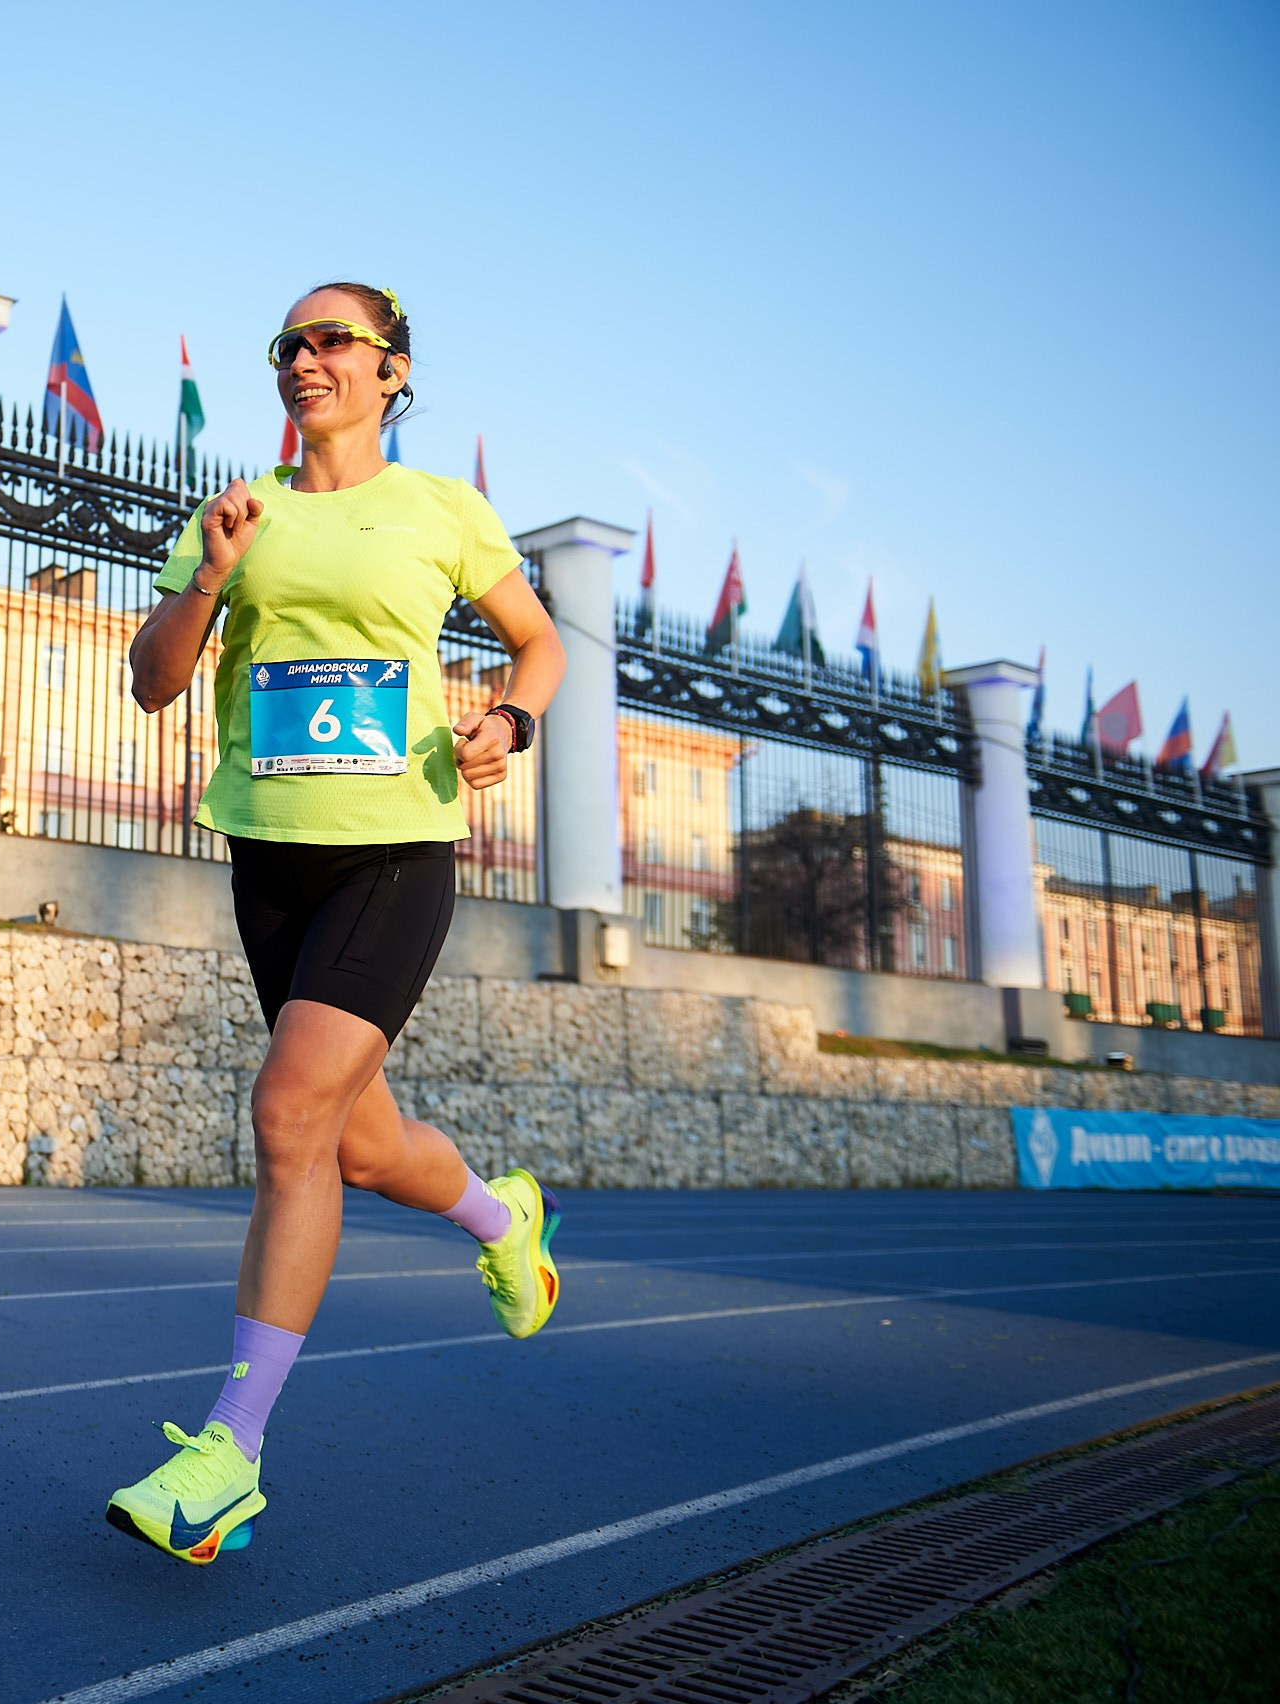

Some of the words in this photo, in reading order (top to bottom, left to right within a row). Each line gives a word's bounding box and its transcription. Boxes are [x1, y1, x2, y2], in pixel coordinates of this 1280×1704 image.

[287, 662, 369, 675] ДИНАМОВСКАЯ
[310, 674, 342, 684] МИЛЯ
[308, 699, 342, 743] 6
